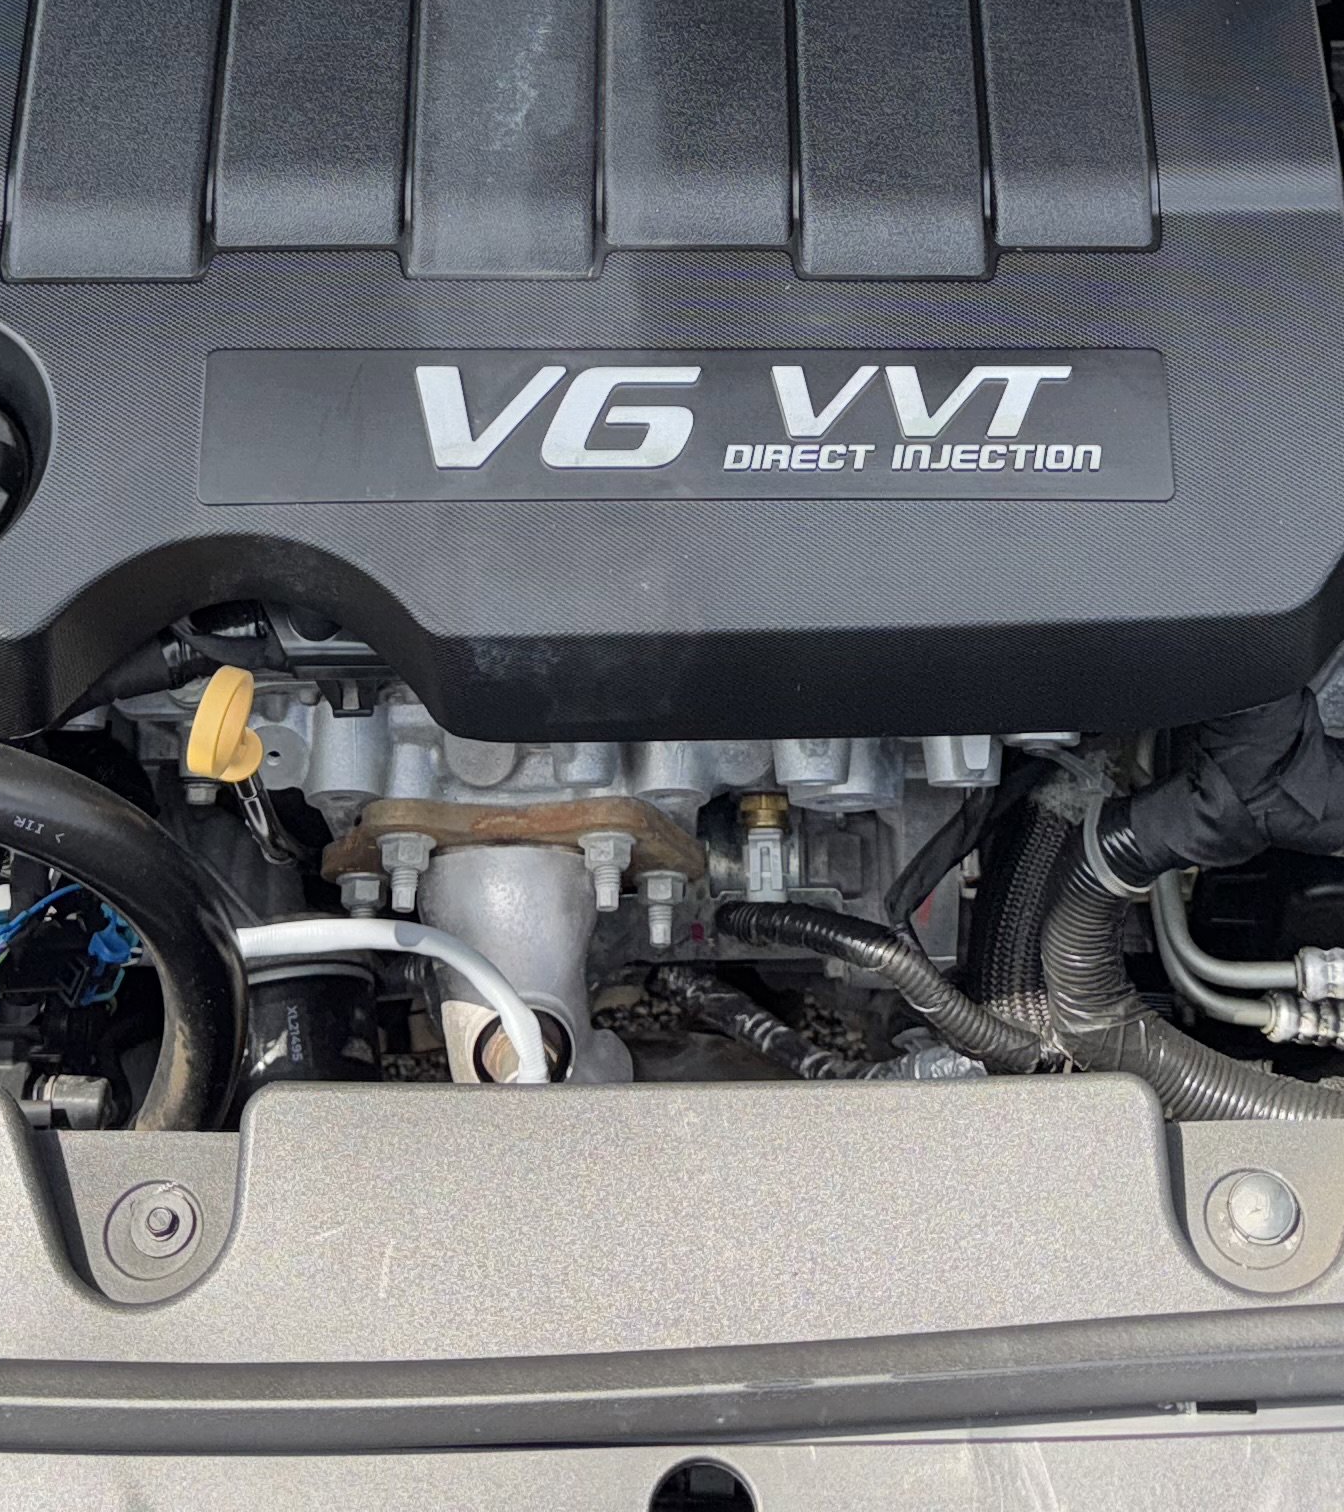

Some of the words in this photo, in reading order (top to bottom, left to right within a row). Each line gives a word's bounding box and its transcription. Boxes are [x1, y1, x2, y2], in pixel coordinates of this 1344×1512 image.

[414, 364, 703, 471] V6
[770, 364, 1074, 439] VVT
[723, 443, 876, 472] DIRECT
[890, 443, 1102, 472] INJECTION
[11, 813, 45, 835] IIR
[287, 1005, 303, 1063] XL21495
